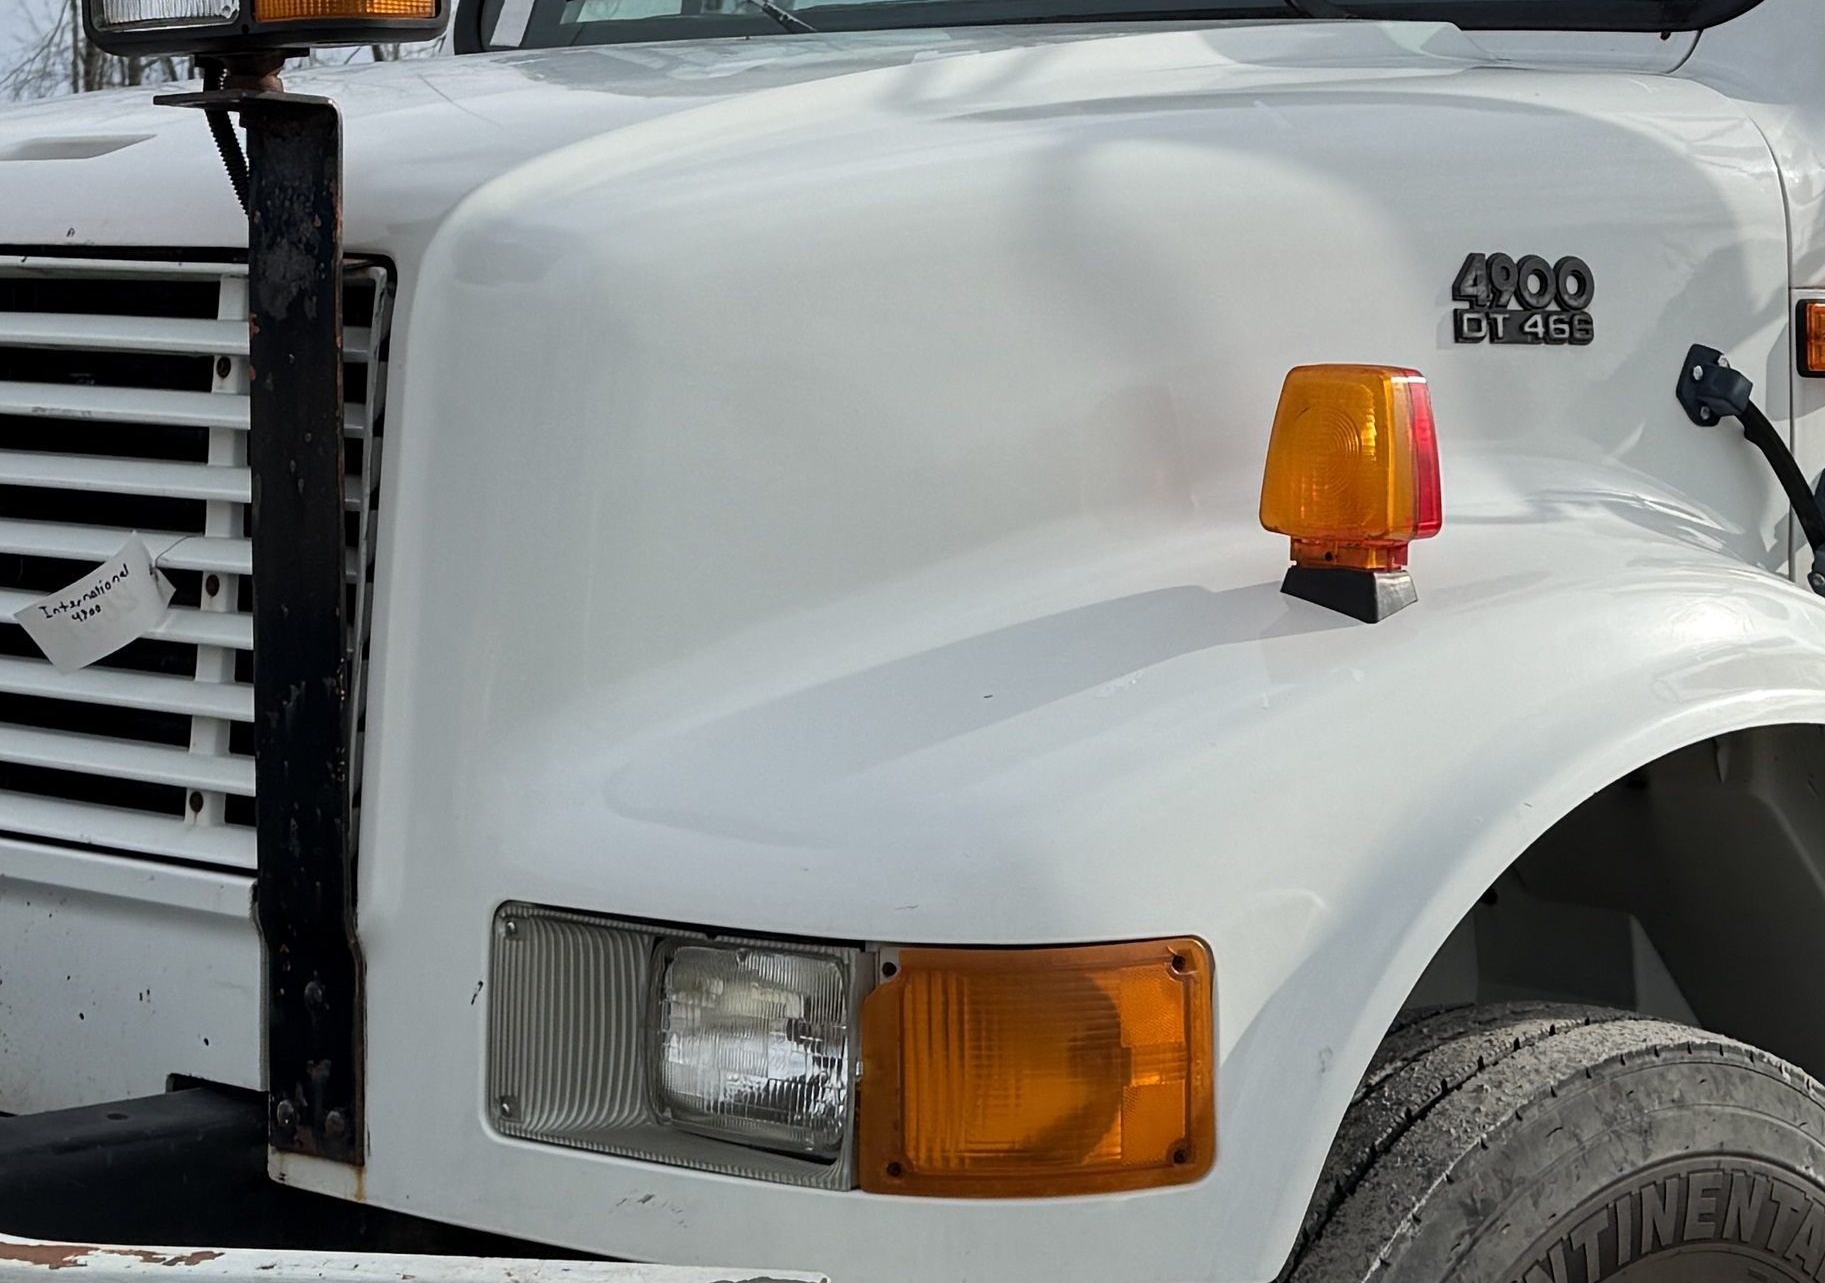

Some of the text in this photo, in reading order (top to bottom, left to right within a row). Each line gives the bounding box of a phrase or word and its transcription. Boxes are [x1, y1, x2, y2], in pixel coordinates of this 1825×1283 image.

[1451, 251, 1595, 311] 4900
[1460, 311, 1594, 341] DT 466
